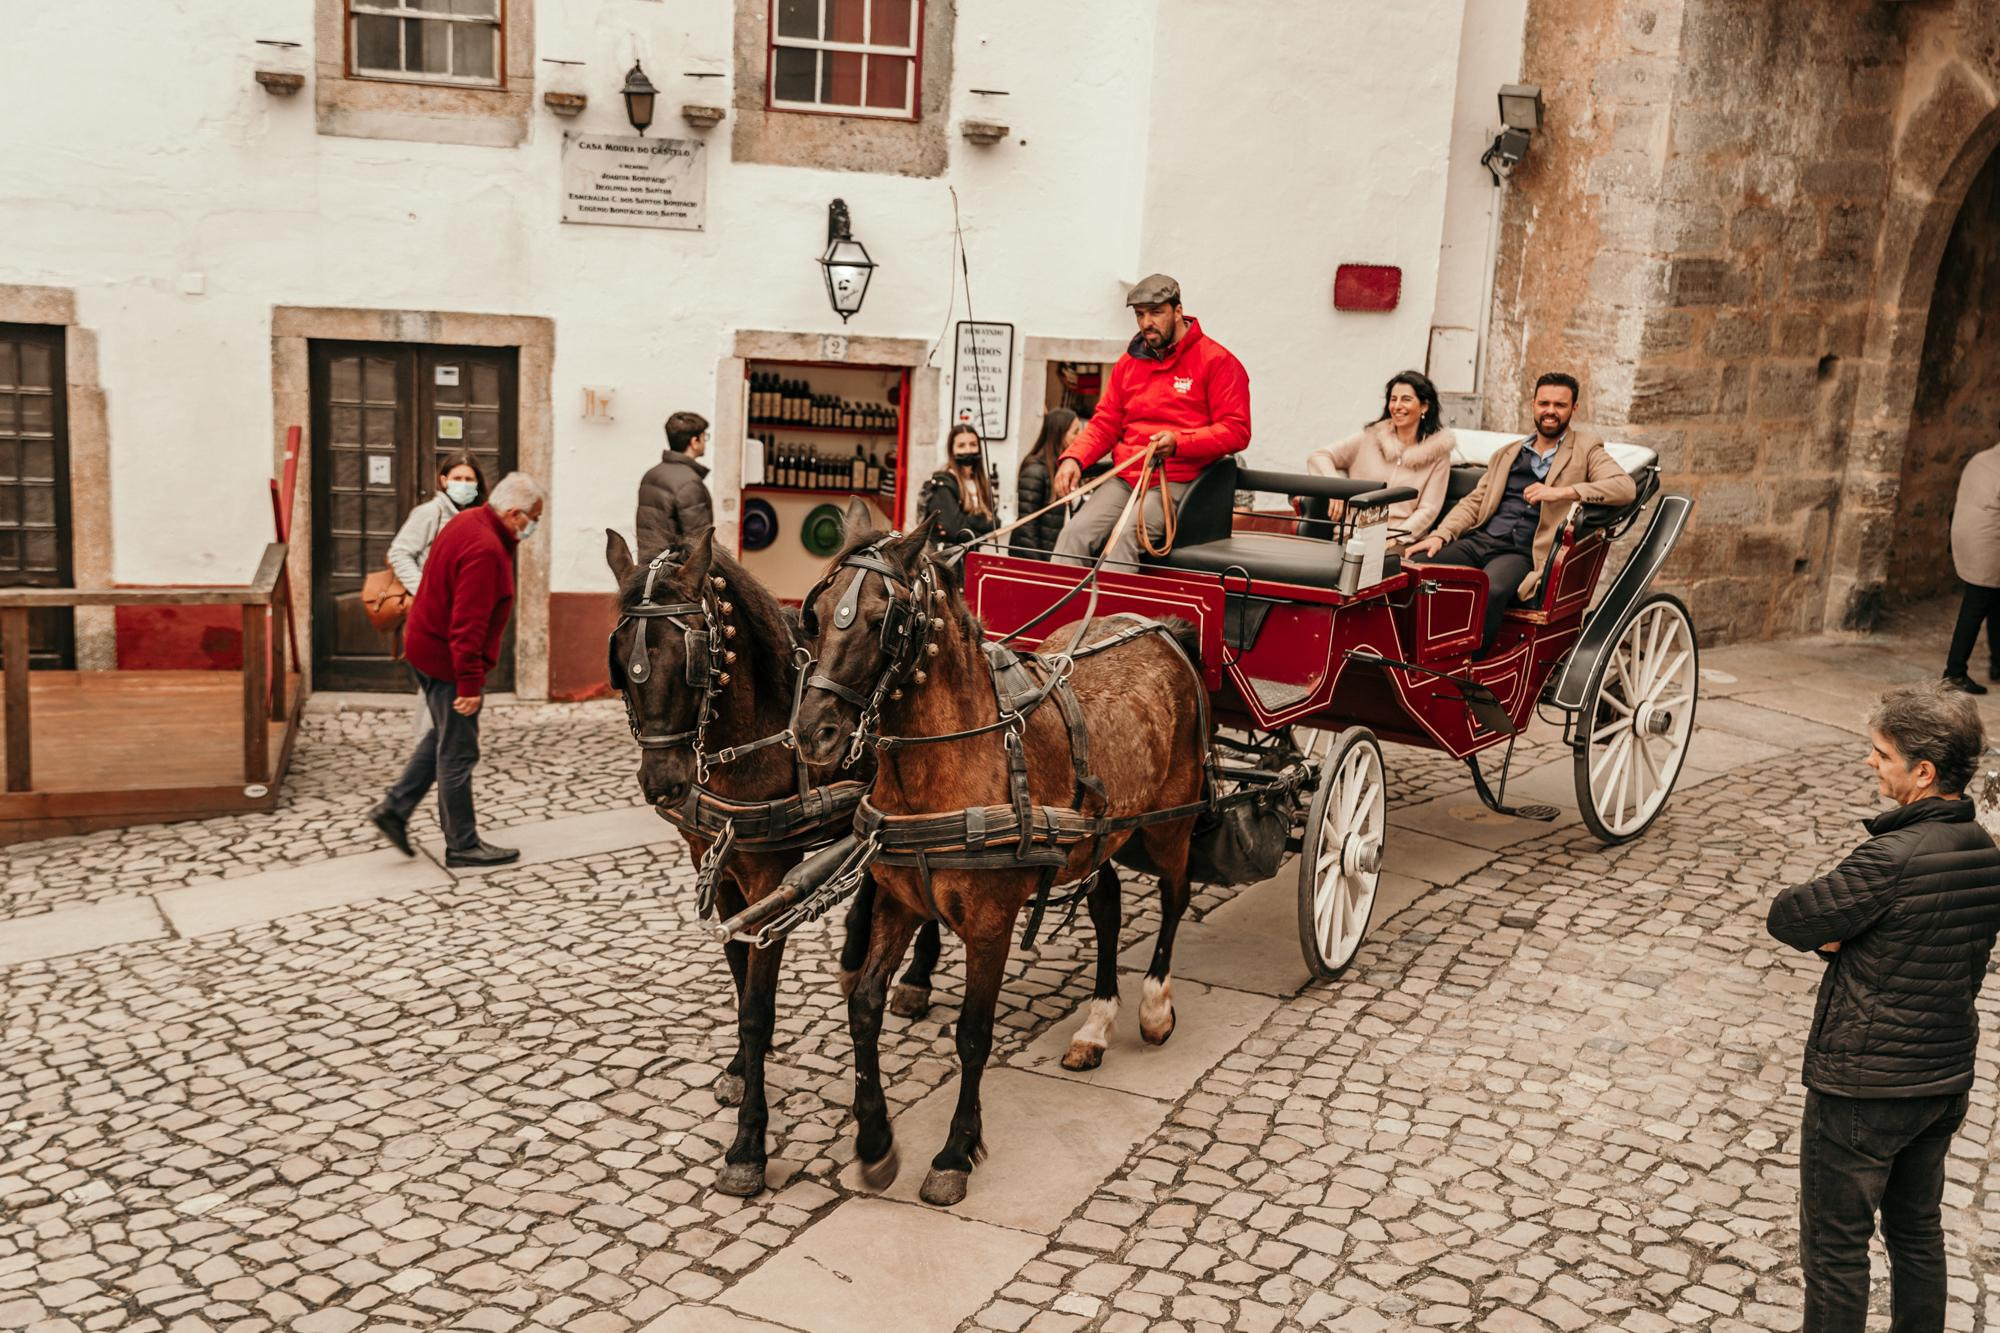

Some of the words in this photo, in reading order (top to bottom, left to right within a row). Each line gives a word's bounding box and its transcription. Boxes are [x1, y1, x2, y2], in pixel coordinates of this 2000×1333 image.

[579, 142, 602, 150] CASA
[605, 143, 634, 152] MOURA
[651, 147, 690, 157] CASTELO
[831, 340, 840, 354] 2
